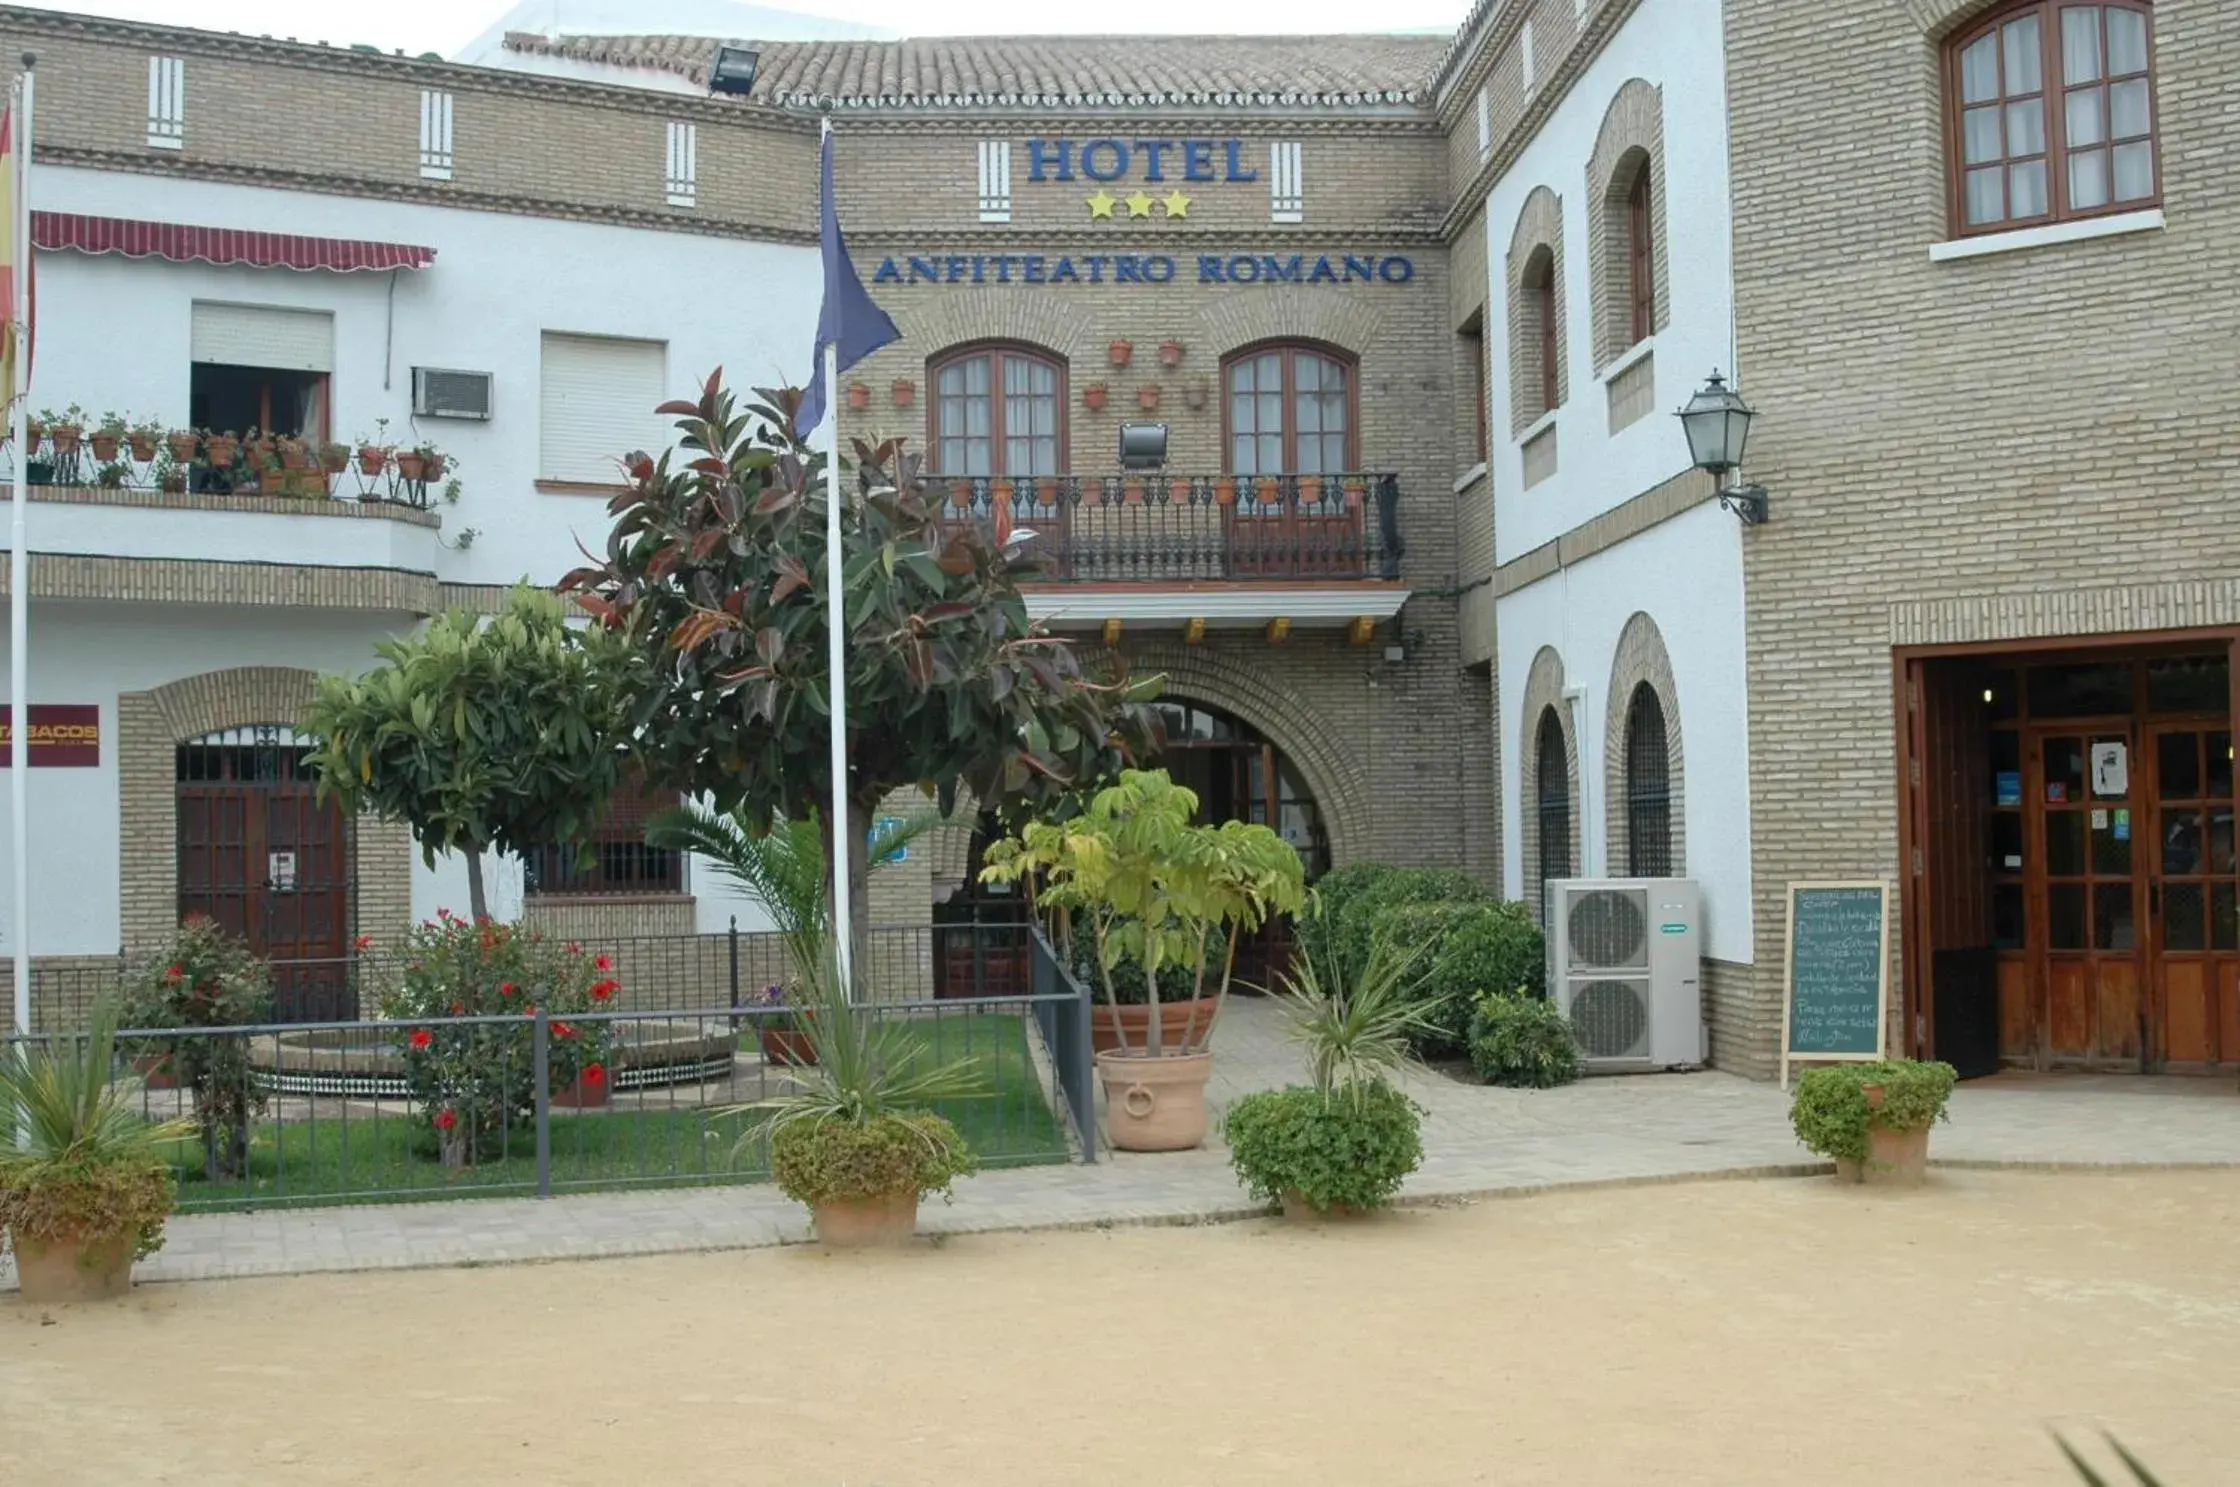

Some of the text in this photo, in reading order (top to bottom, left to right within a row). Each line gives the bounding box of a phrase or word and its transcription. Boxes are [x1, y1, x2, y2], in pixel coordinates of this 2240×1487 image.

[1026, 139, 1258, 182] HOTEL
[873, 255, 1414, 284] ANFITEATRO ROMANO
